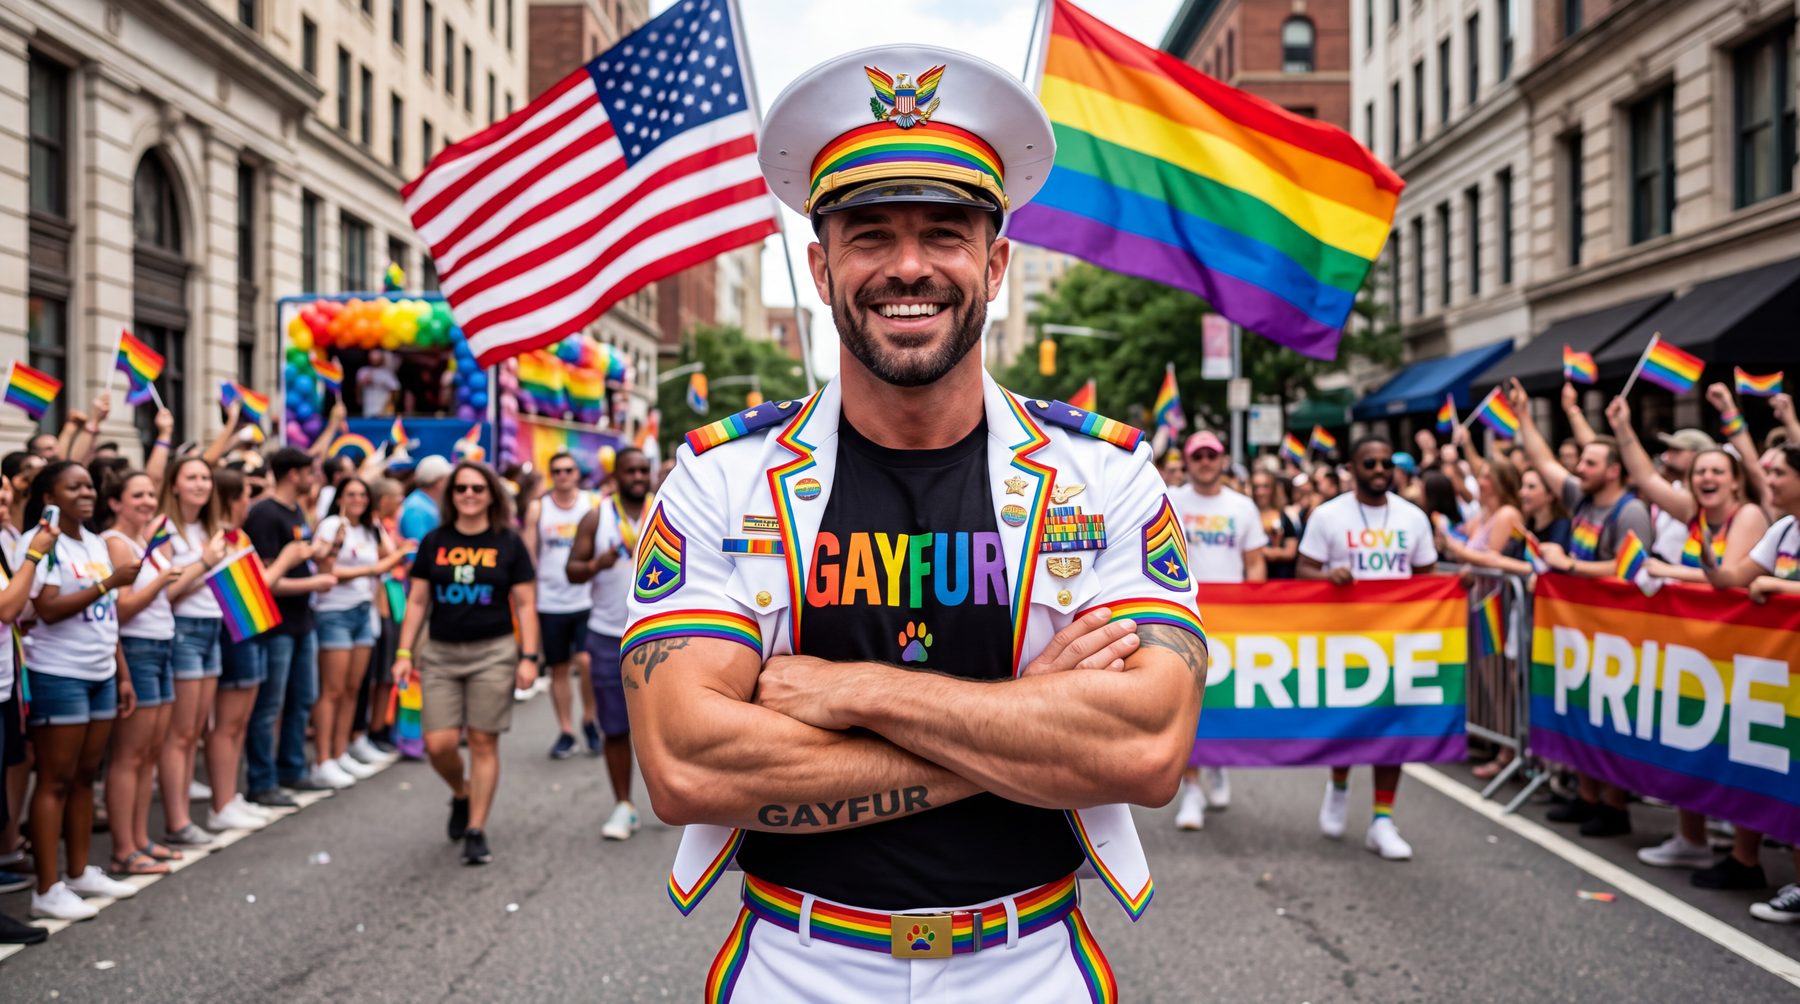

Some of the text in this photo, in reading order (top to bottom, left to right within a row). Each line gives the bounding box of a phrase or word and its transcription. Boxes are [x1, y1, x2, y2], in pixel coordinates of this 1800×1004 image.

[1346, 528, 1408, 549] LOVE
[435, 546, 497, 568] LOVE
[1358, 552, 1406, 572] LOVE
[454, 564, 475, 584] IS
[806, 531, 1010, 608] GAYFUR
[435, 583, 494, 605] LOVE
[1204, 632, 1444, 709] PRIDE
[1553, 624, 1790, 775] PRIDE
[757, 784, 932, 827] GAYFUR
